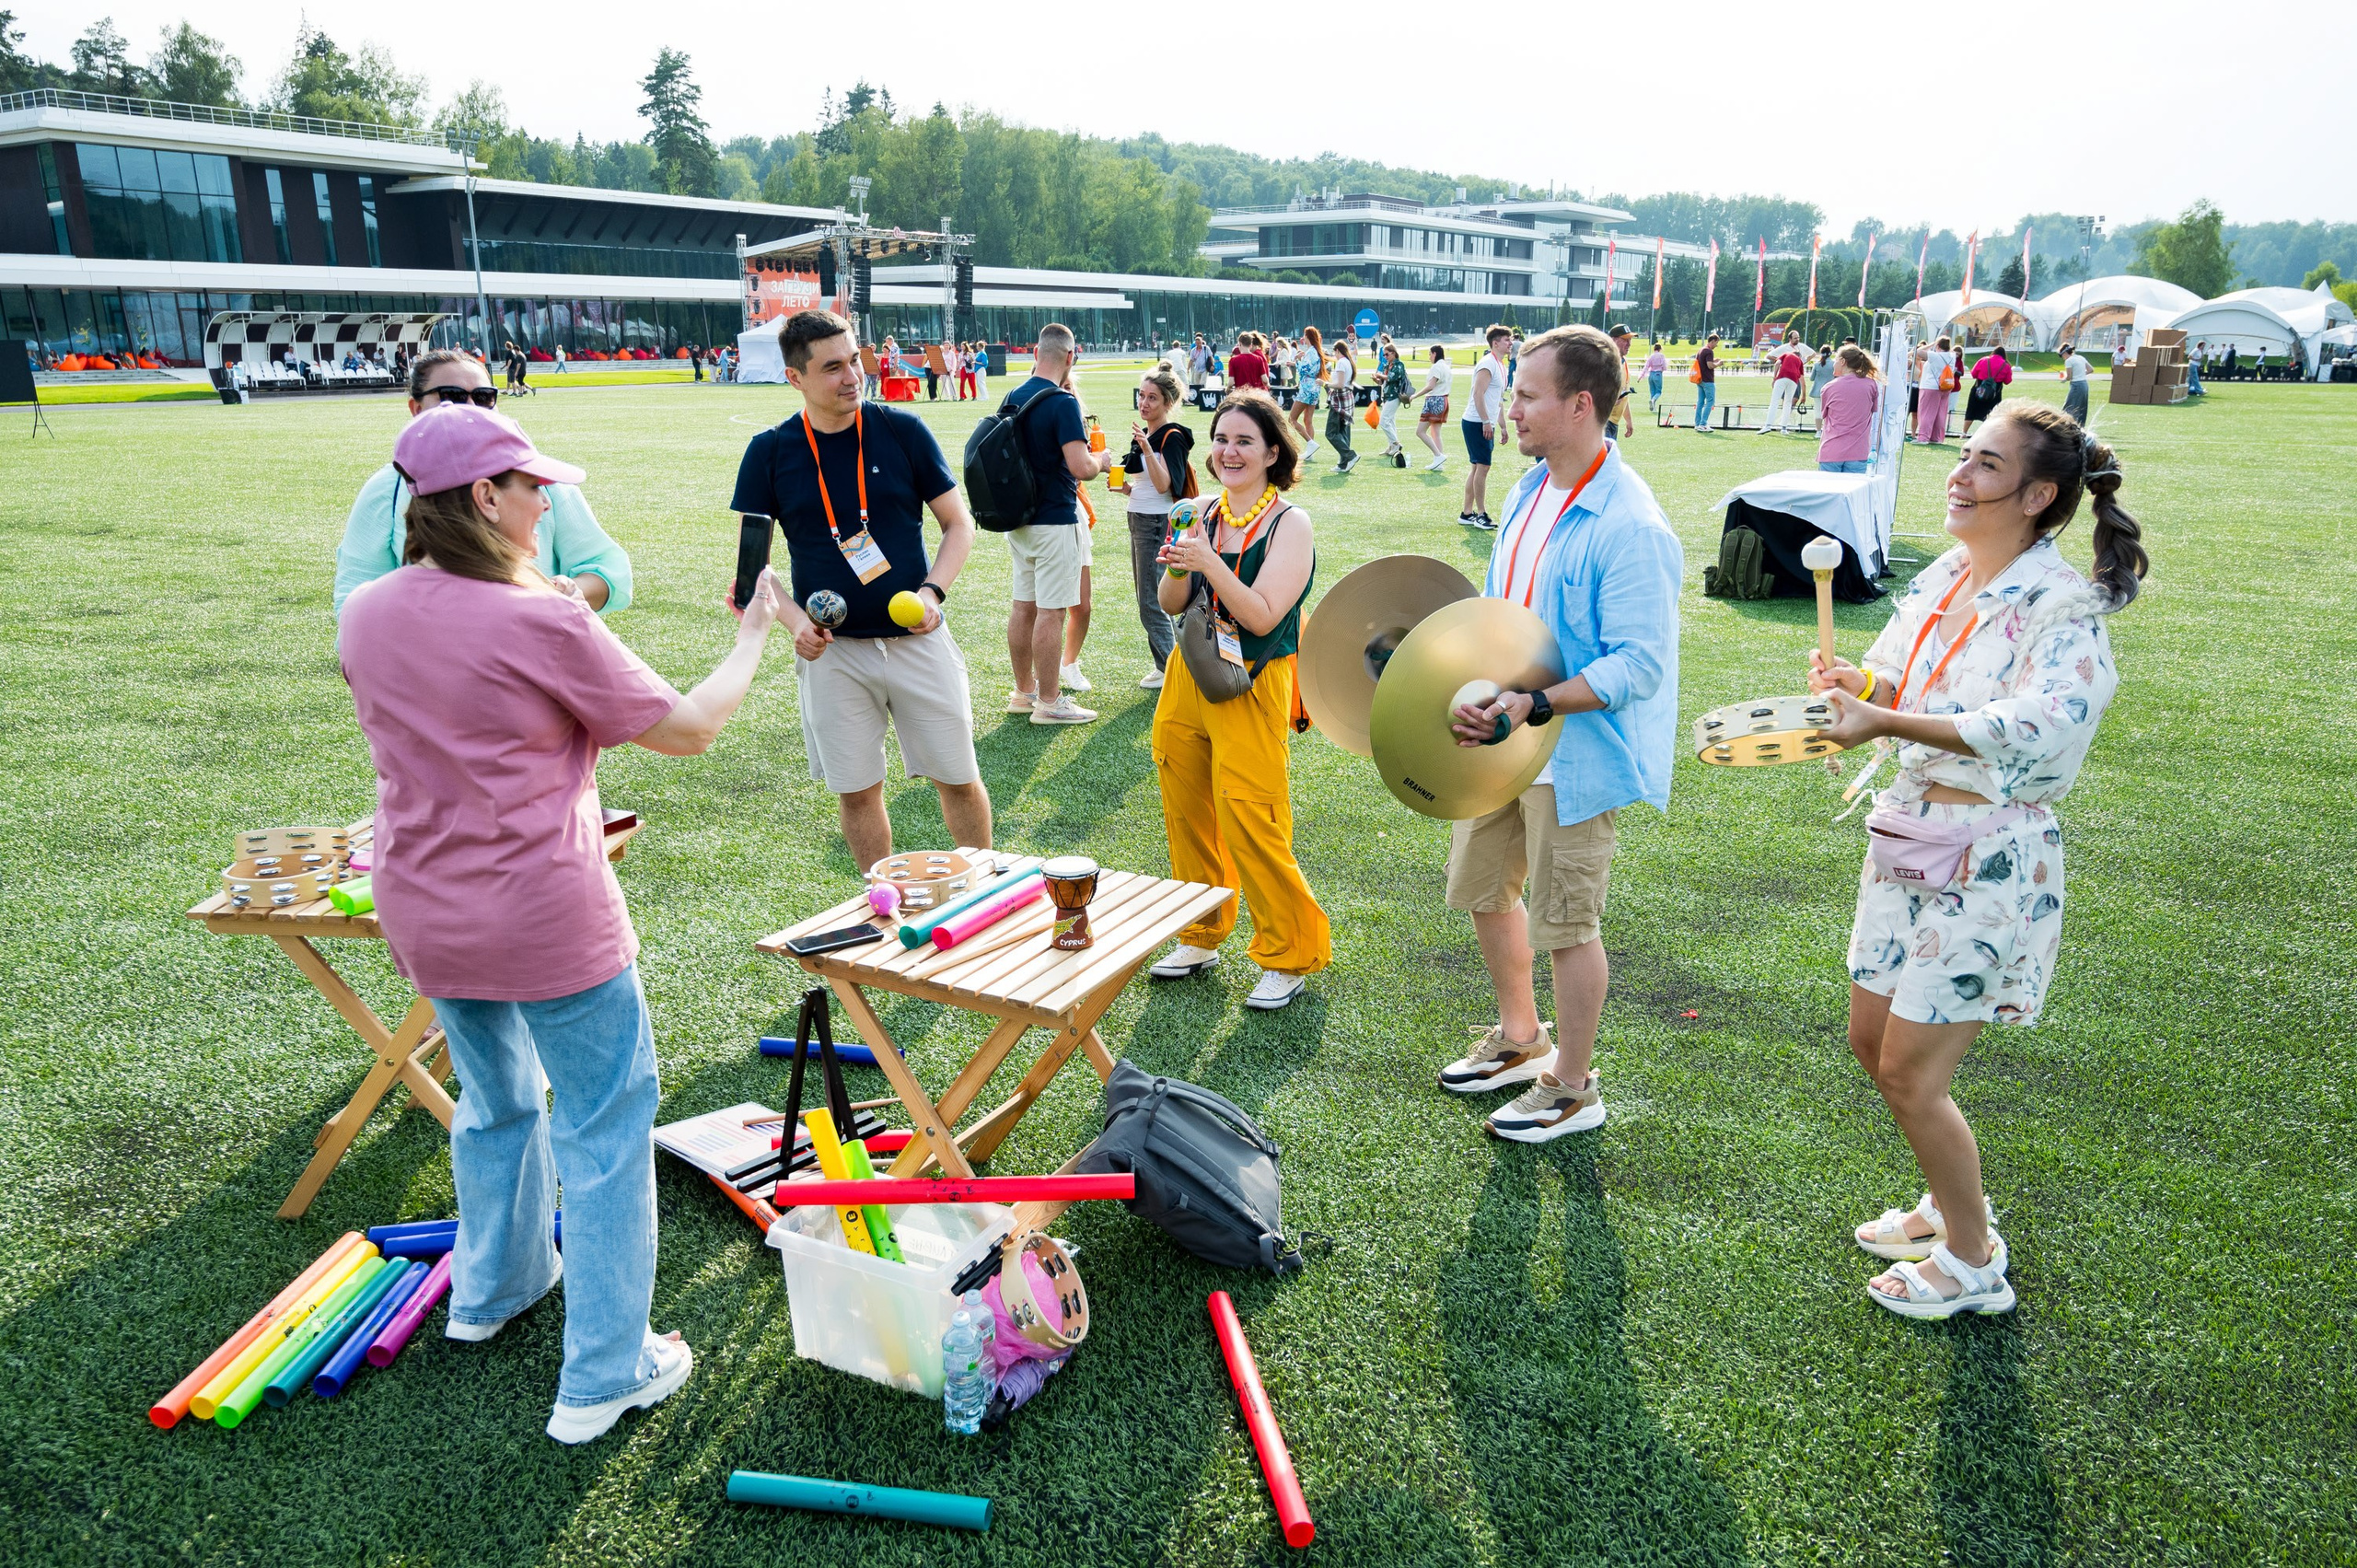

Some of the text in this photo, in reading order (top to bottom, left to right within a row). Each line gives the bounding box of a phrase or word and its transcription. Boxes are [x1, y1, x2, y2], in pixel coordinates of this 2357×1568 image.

[771, 280, 820, 295] ЗАГРУЗИ
[782, 296, 810, 308] ЛЕТО
[1402, 777, 1436, 803] BRAHNER
[1060, 938, 1086, 947] CYPRUS
